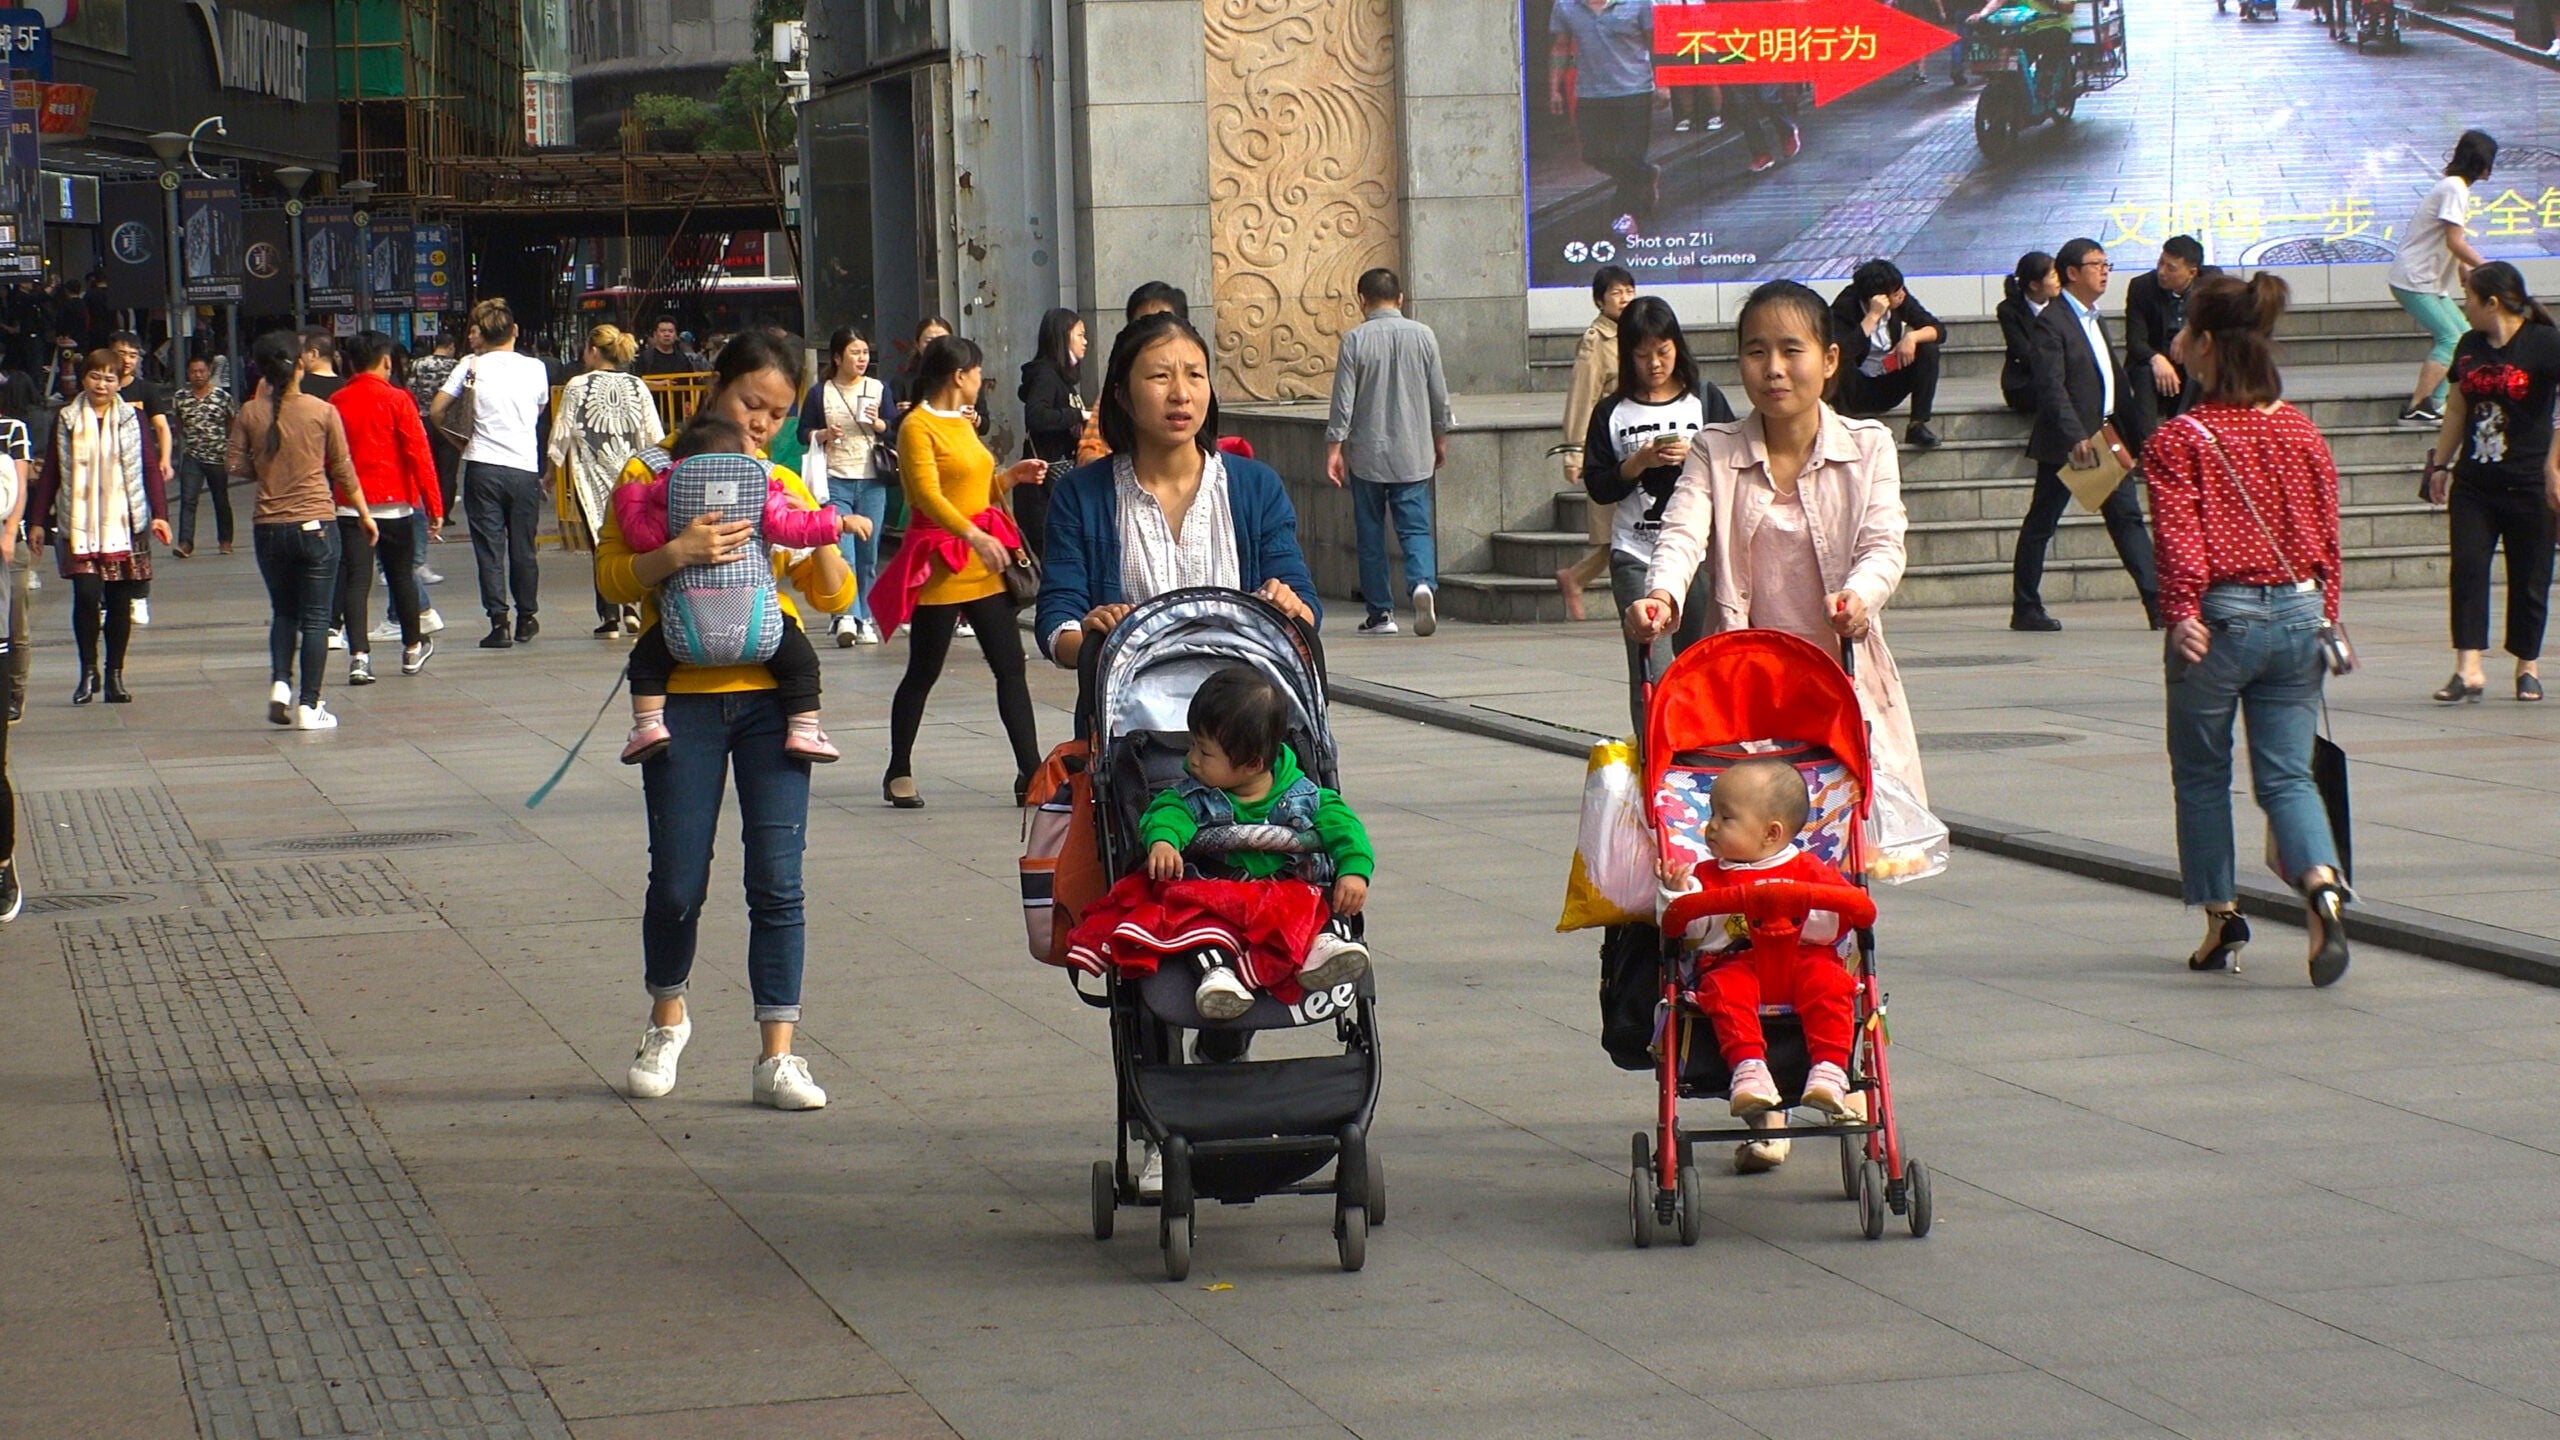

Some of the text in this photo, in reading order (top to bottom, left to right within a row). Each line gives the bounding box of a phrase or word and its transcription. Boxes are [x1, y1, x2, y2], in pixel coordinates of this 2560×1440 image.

[16, 26, 41, 51] 5F
[1676, 25, 1877, 65] 不文明行为
[263, 19, 308, 103] OUTLET
[1626, 232, 1714, 249] Shot on Z1i
[1626, 252, 1757, 267] vivo dual camera
